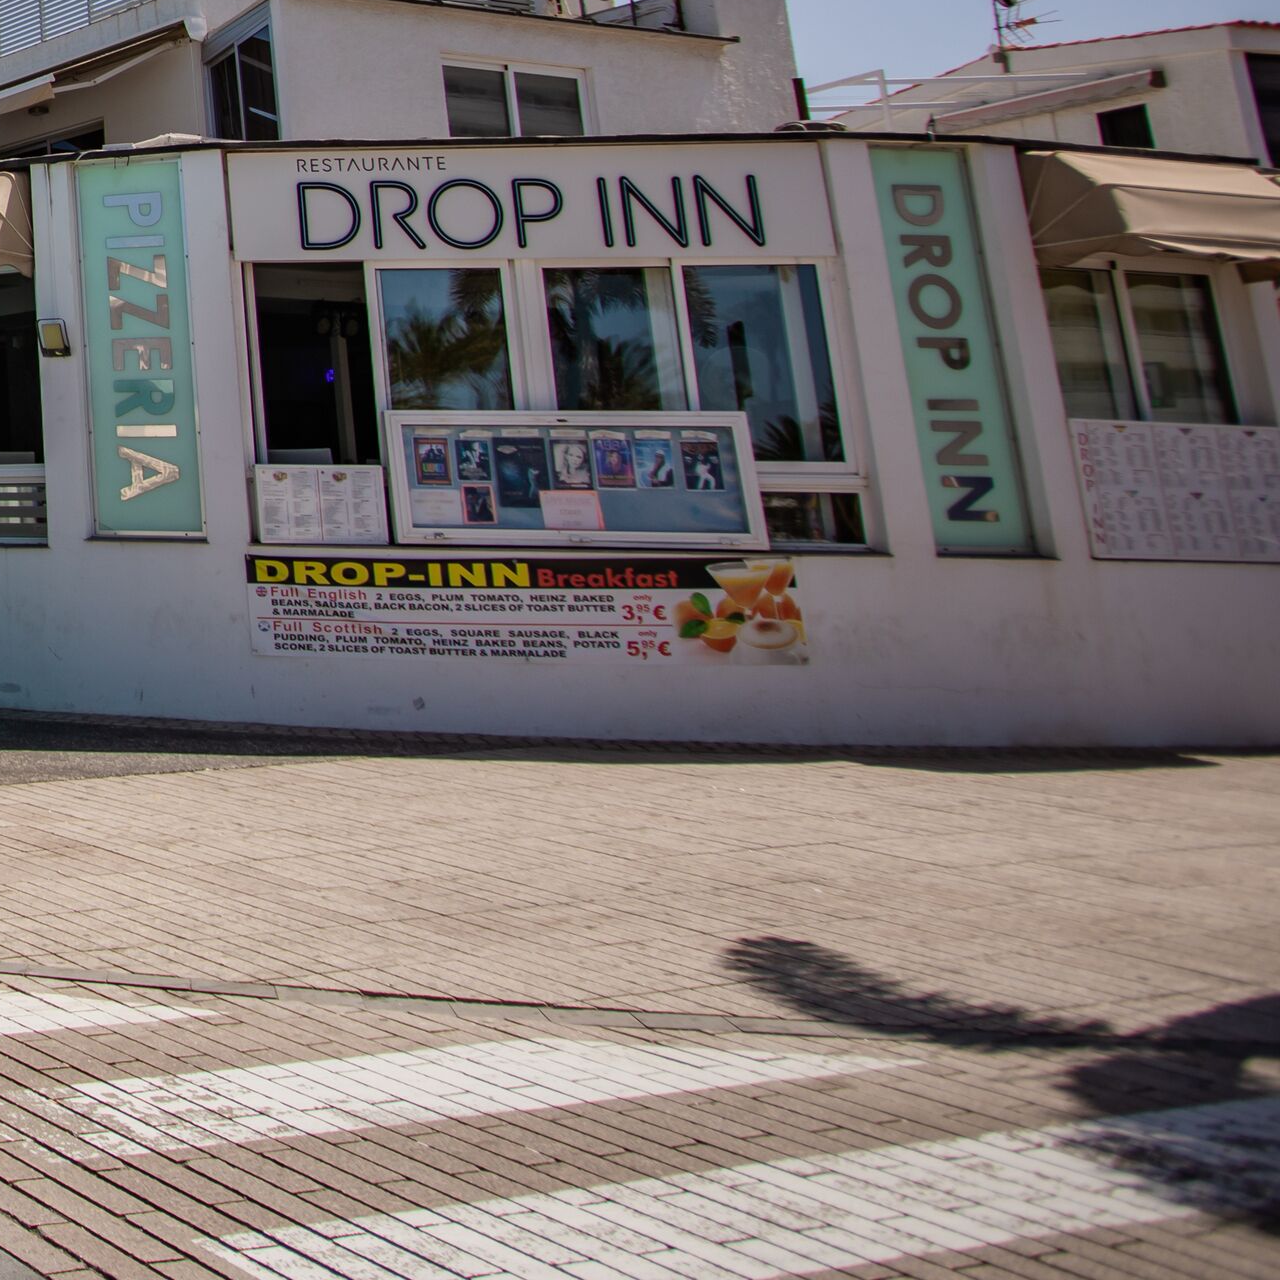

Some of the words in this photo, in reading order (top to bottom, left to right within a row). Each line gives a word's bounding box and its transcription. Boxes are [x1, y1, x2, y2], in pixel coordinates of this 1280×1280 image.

[296, 156, 446, 173] RESTAURANTE
[296, 178, 563, 251] DROP
[597, 174, 765, 248] INN
[891, 184, 970, 371] DROP
[102, 191, 180, 501] PIZZERIA
[927, 398, 1000, 522] INN
[254, 560, 531, 587] DROP-INN
[537, 568, 678, 588] Breakfast
[271, 586, 298, 597] Full
[308, 588, 367, 601] English
[390, 593, 424, 603] EGGS,
[471, 594, 523, 603] TOMATO,
[633, 594, 652, 602] only
[271, 599, 313, 609] BEANS,
[316, 600, 371, 610] SAUSAGE,
[374, 602, 406, 610] BACK
[409, 603, 453, 612] BACON,
[527, 604, 565, 612] TOAST
[568, 604, 616, 612] BUTTER
[283, 609, 355, 618] MARMALADE
[273, 621, 302, 632] Full
[313, 622, 382, 635] Scottish
[406, 628, 442, 638] EGGS,
[451, 629, 500, 638] SQUARE
[509, 630, 570, 640] SAUSAGE,
[578, 630, 618, 639] BLACK
[638, 630, 657, 638] only
[274, 633, 329, 643] PUDDING,
[336, 635, 367, 643] PLUM
[375, 637, 426, 647] TOMATO,
[475, 639, 515, 647] BAKED
[523, 640, 567, 649] BEANS,
[573, 640, 620, 649] POTATO
[274, 643, 317, 653] SCONE,
[319, 644, 325, 652] 2
[327, 645, 368, 653] SLICES
[371, 646, 385, 654] OF
[389, 647, 425, 655] TOAST
[430, 648, 476, 656] BUTTER
[491, 649, 567, 658] MARMALADE
